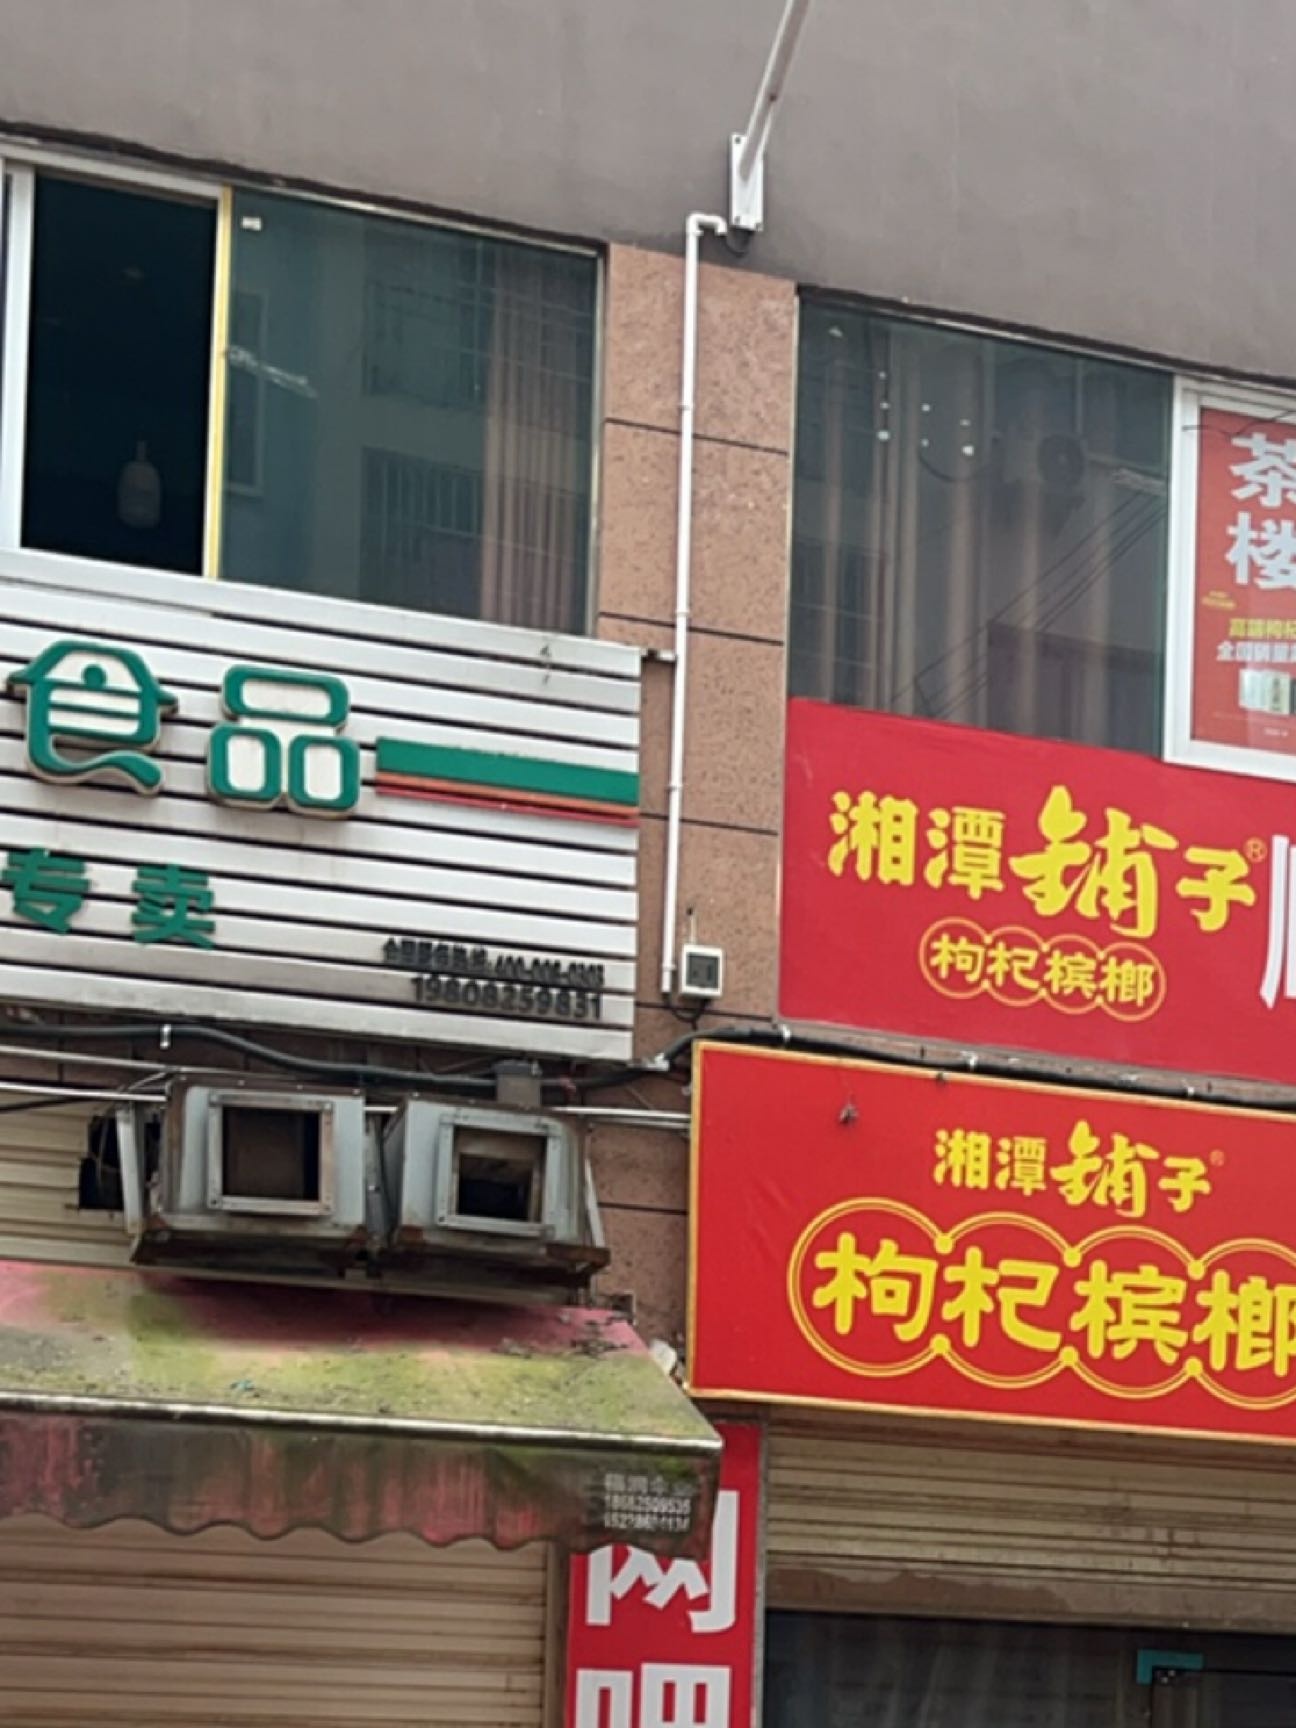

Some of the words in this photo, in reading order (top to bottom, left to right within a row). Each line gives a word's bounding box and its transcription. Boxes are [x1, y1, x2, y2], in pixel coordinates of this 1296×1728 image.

[7, 640, 360, 818] 食品
[1, 847, 215, 949] 专卖
[828, 785, 1257, 938] 湘潭铺子
[930, 933, 1156, 1008] 枸杞槟榔
[933, 1120, 1212, 1218] 湘潭铺子
